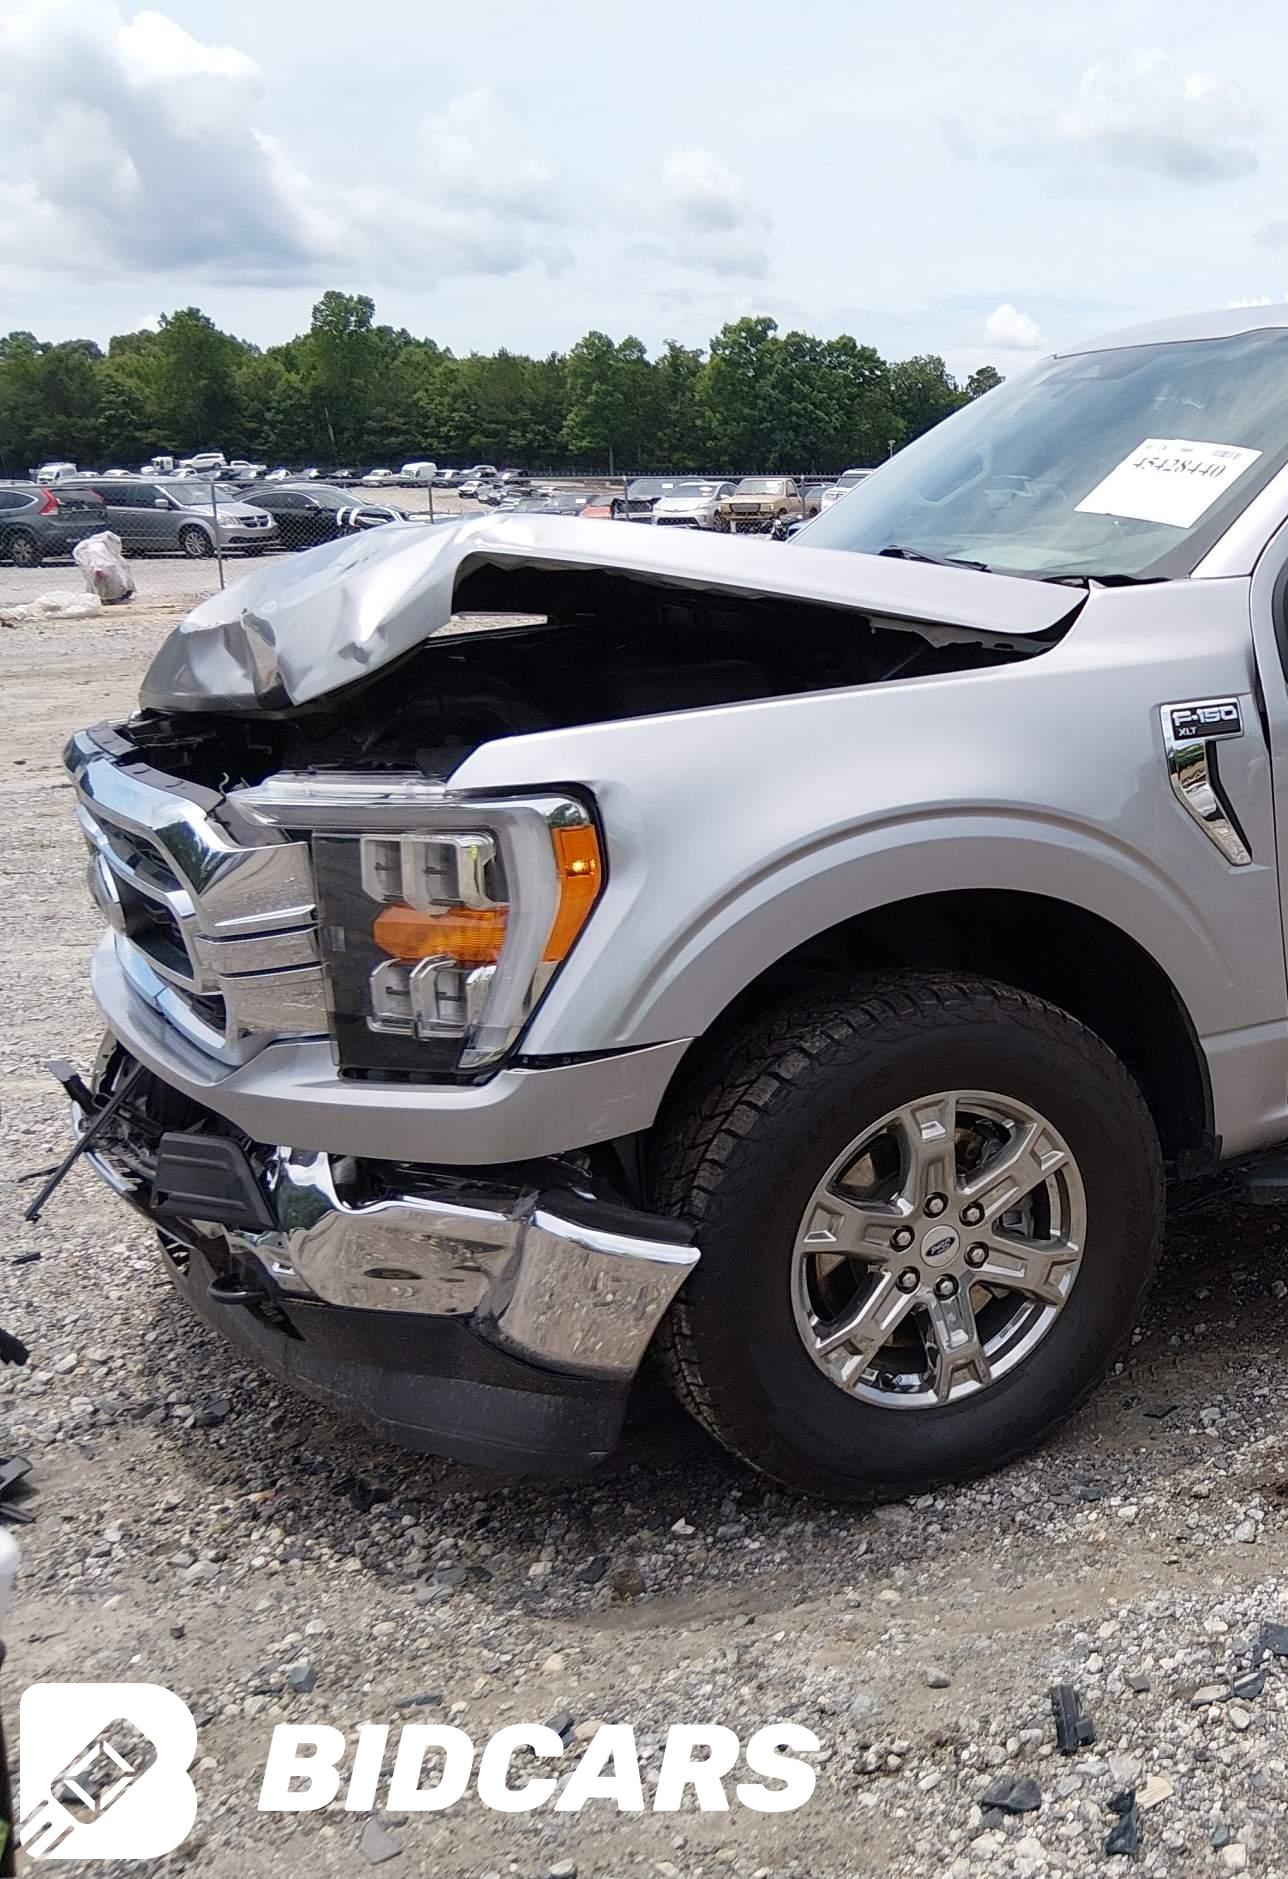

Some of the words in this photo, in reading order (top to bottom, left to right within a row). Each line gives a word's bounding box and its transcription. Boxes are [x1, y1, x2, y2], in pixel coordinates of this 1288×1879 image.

[1133, 457, 1226, 478] 45428440
[1172, 704, 1239, 727] F-150
[1178, 726, 1198, 737] XLT
